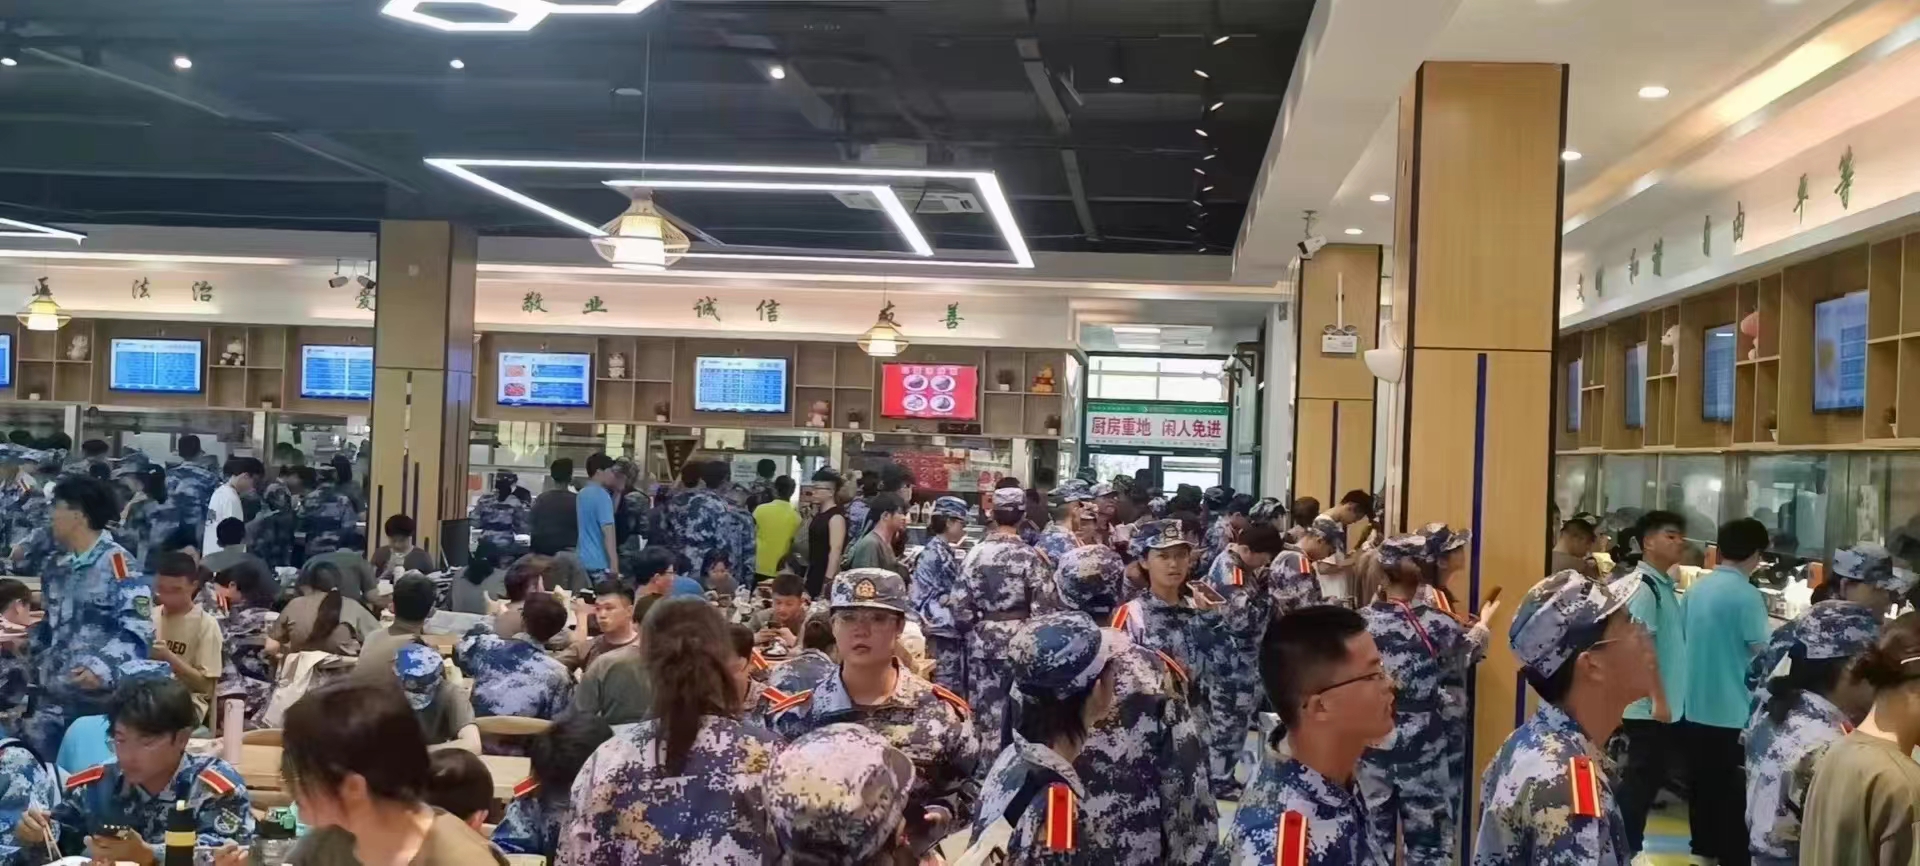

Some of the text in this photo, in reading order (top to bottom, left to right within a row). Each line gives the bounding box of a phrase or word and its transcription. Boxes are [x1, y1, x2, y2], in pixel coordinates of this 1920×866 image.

[132, 277, 213, 302] 法治
[522, 289, 608, 314] 敬业
[692, 295, 781, 323] 诚信
[1091, 416, 1222, 438] 厨房重地 闲人免进
